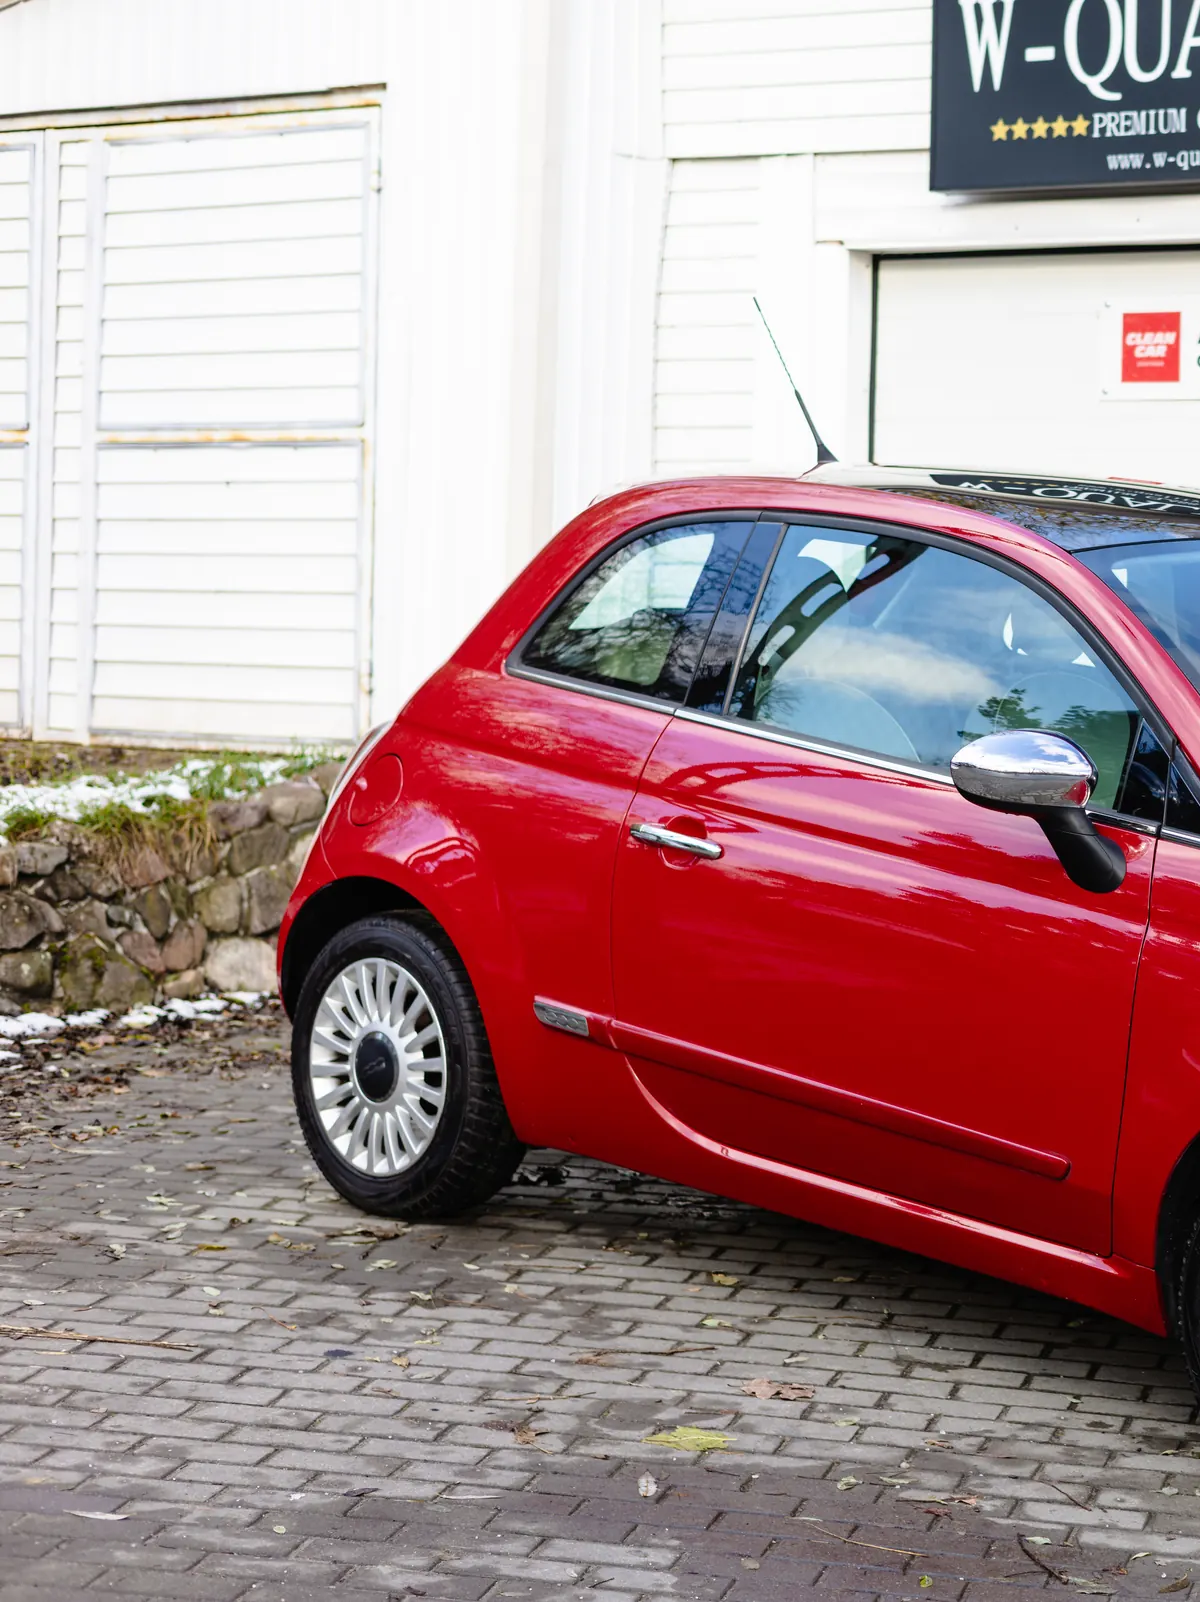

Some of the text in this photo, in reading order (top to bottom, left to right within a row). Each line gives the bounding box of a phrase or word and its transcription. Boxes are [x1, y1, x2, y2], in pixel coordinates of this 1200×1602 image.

[1092, 107, 1187, 138] PREMIUM
[1125, 331, 1177, 346] CLEAN
[1134, 345, 1168, 358] CAR
